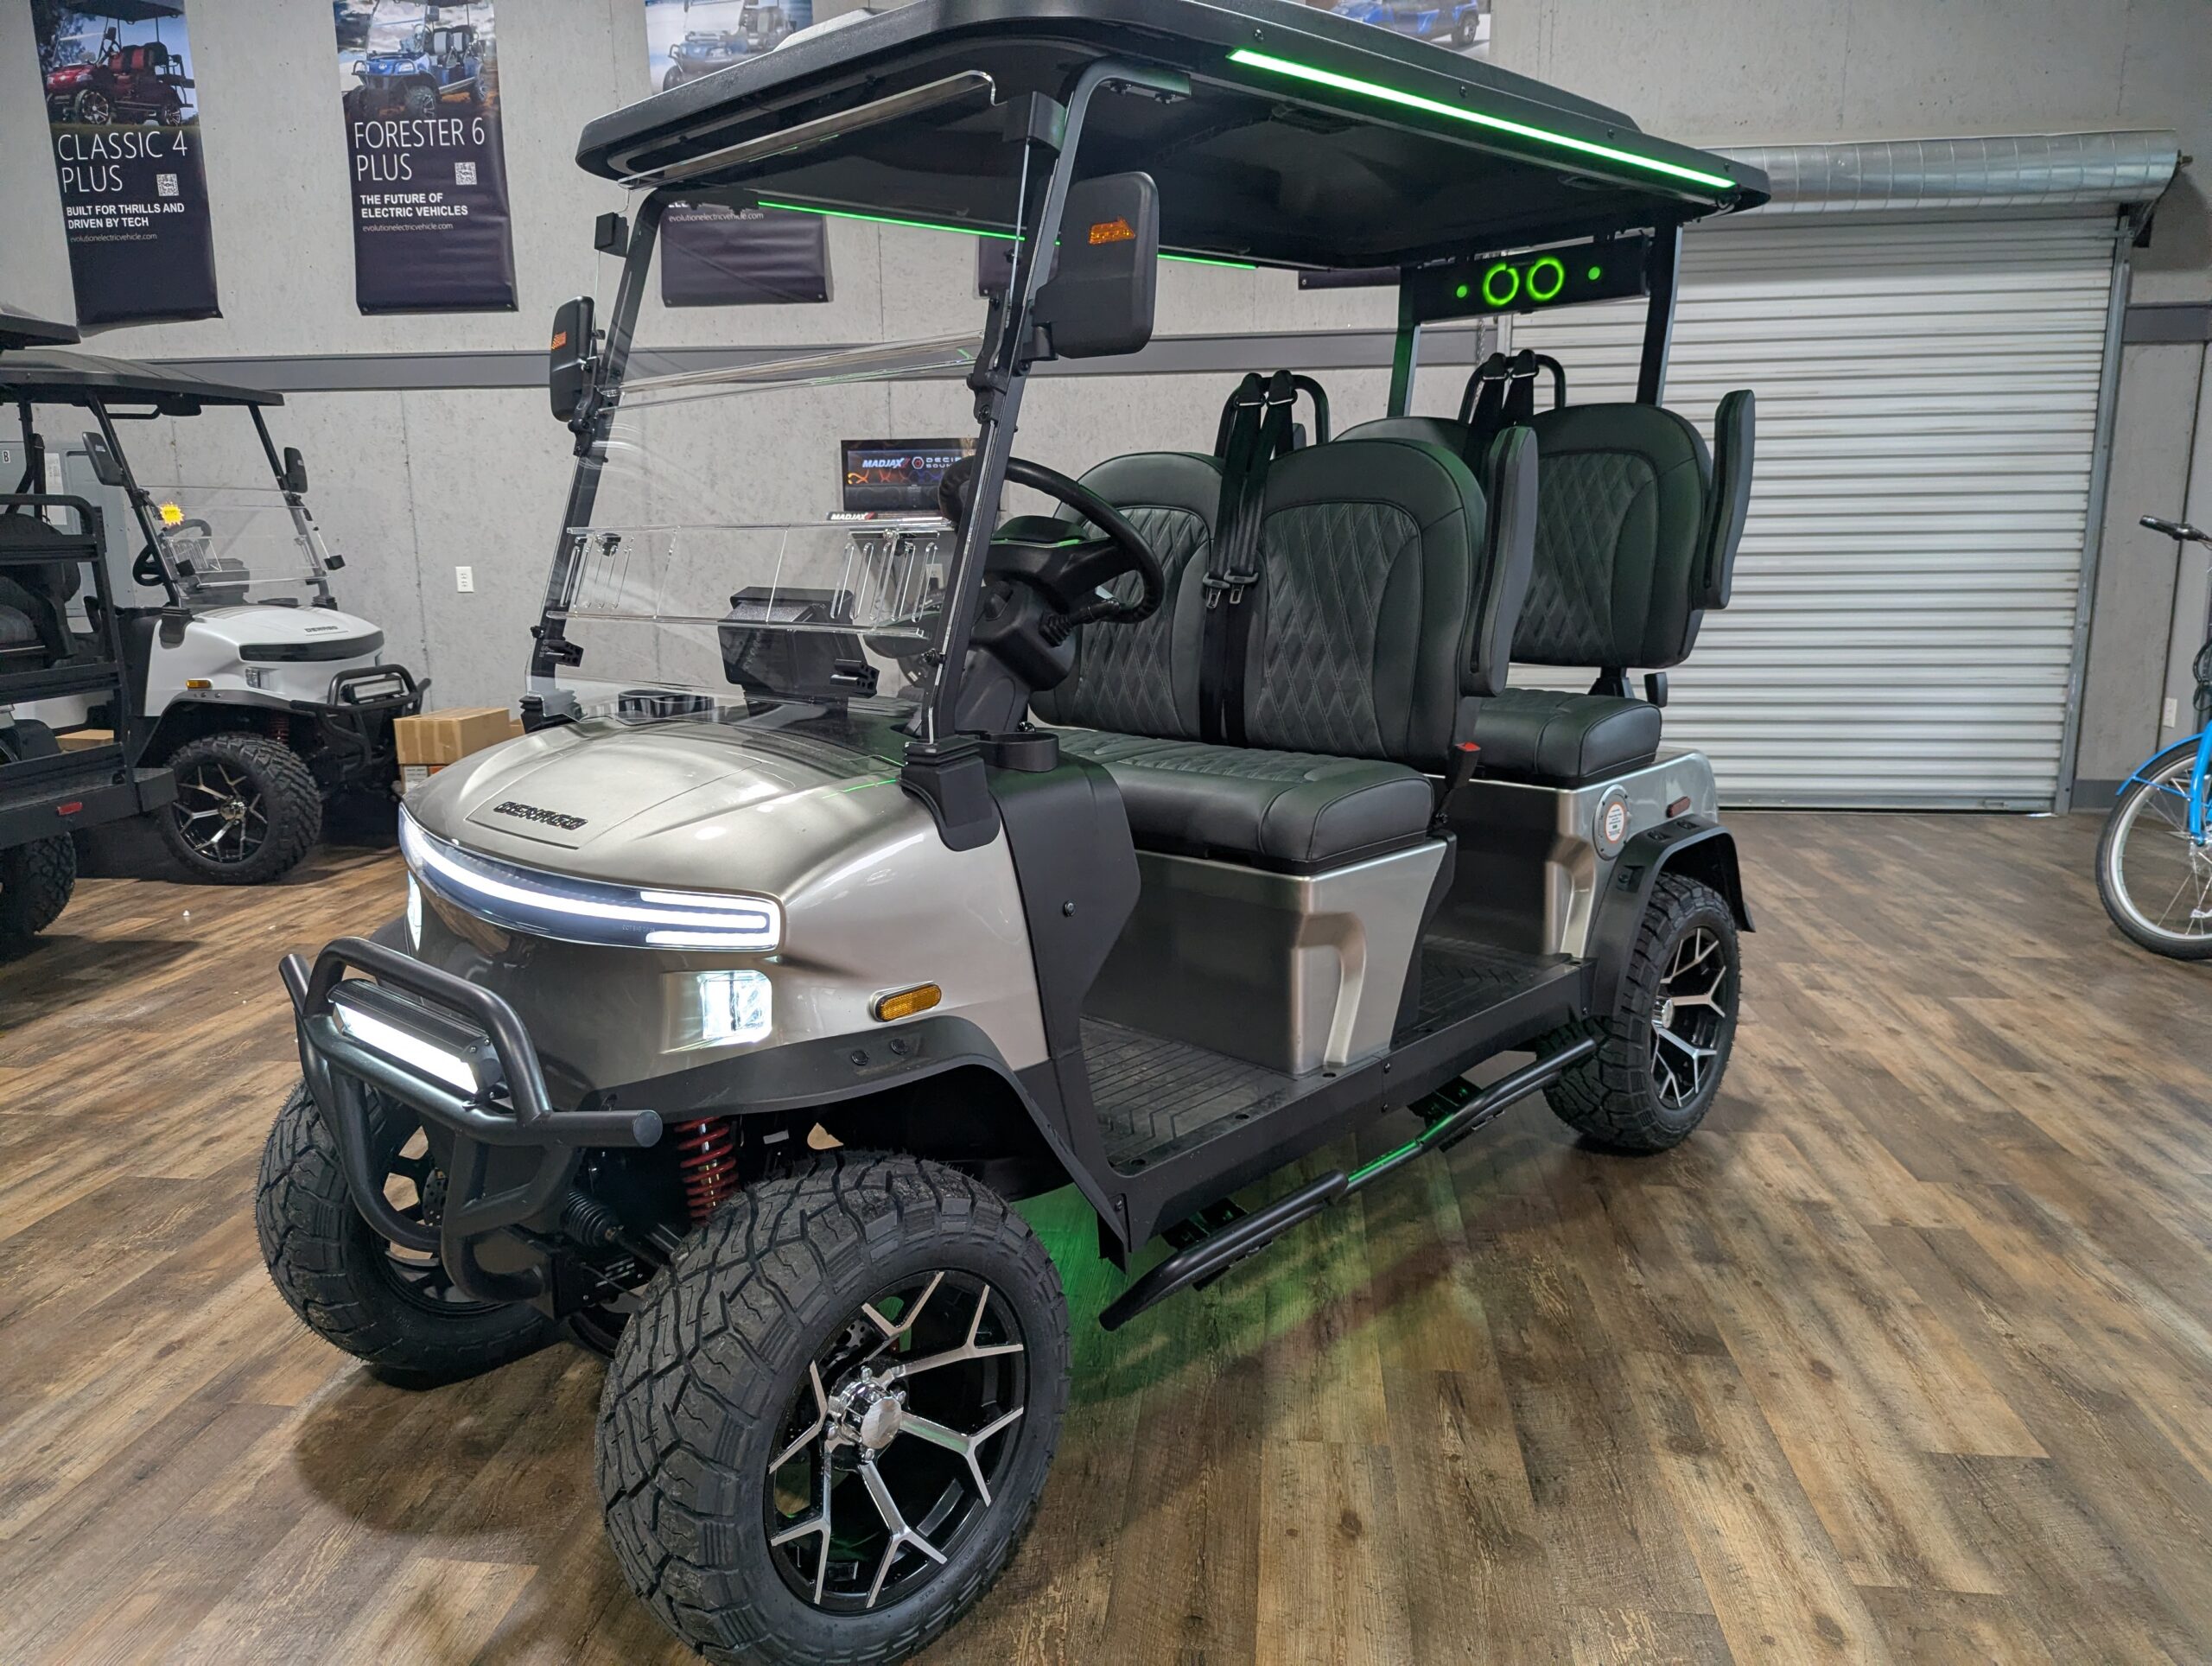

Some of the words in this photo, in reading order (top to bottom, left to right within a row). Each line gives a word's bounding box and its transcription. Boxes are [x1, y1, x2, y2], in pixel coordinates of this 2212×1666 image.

[354, 118, 465, 149] FORESTER
[472, 117, 485, 145] 6
[58, 130, 163, 161] CLASSIC
[172, 130, 188, 156] 4
[356, 153, 412, 181] PLUS
[61, 164, 123, 193] PLUS
[360, 194, 381, 205] THE
[384, 193, 426, 205] FUTURE
[429, 193, 443, 203] OF
[67, 206, 92, 216] BUILT
[95, 205, 117, 215] FOR
[118, 203, 161, 214] THRILLS
[162, 202, 185, 213] AND
[361, 207, 413, 218] ELECTRIC
[415, 205, 468, 216] VEHICLES
[68, 218, 103, 230] DRIVEN
[105, 218, 119, 227] BY
[121, 217, 149, 227] TECH
[363, 222, 454, 232] evolutionelectricvehicle.com
[70, 232, 157, 243] evolutionelectricvehicle.com
[862, 457, 909, 468] MADJAX
[830, 512, 874, 520] MADJAX
